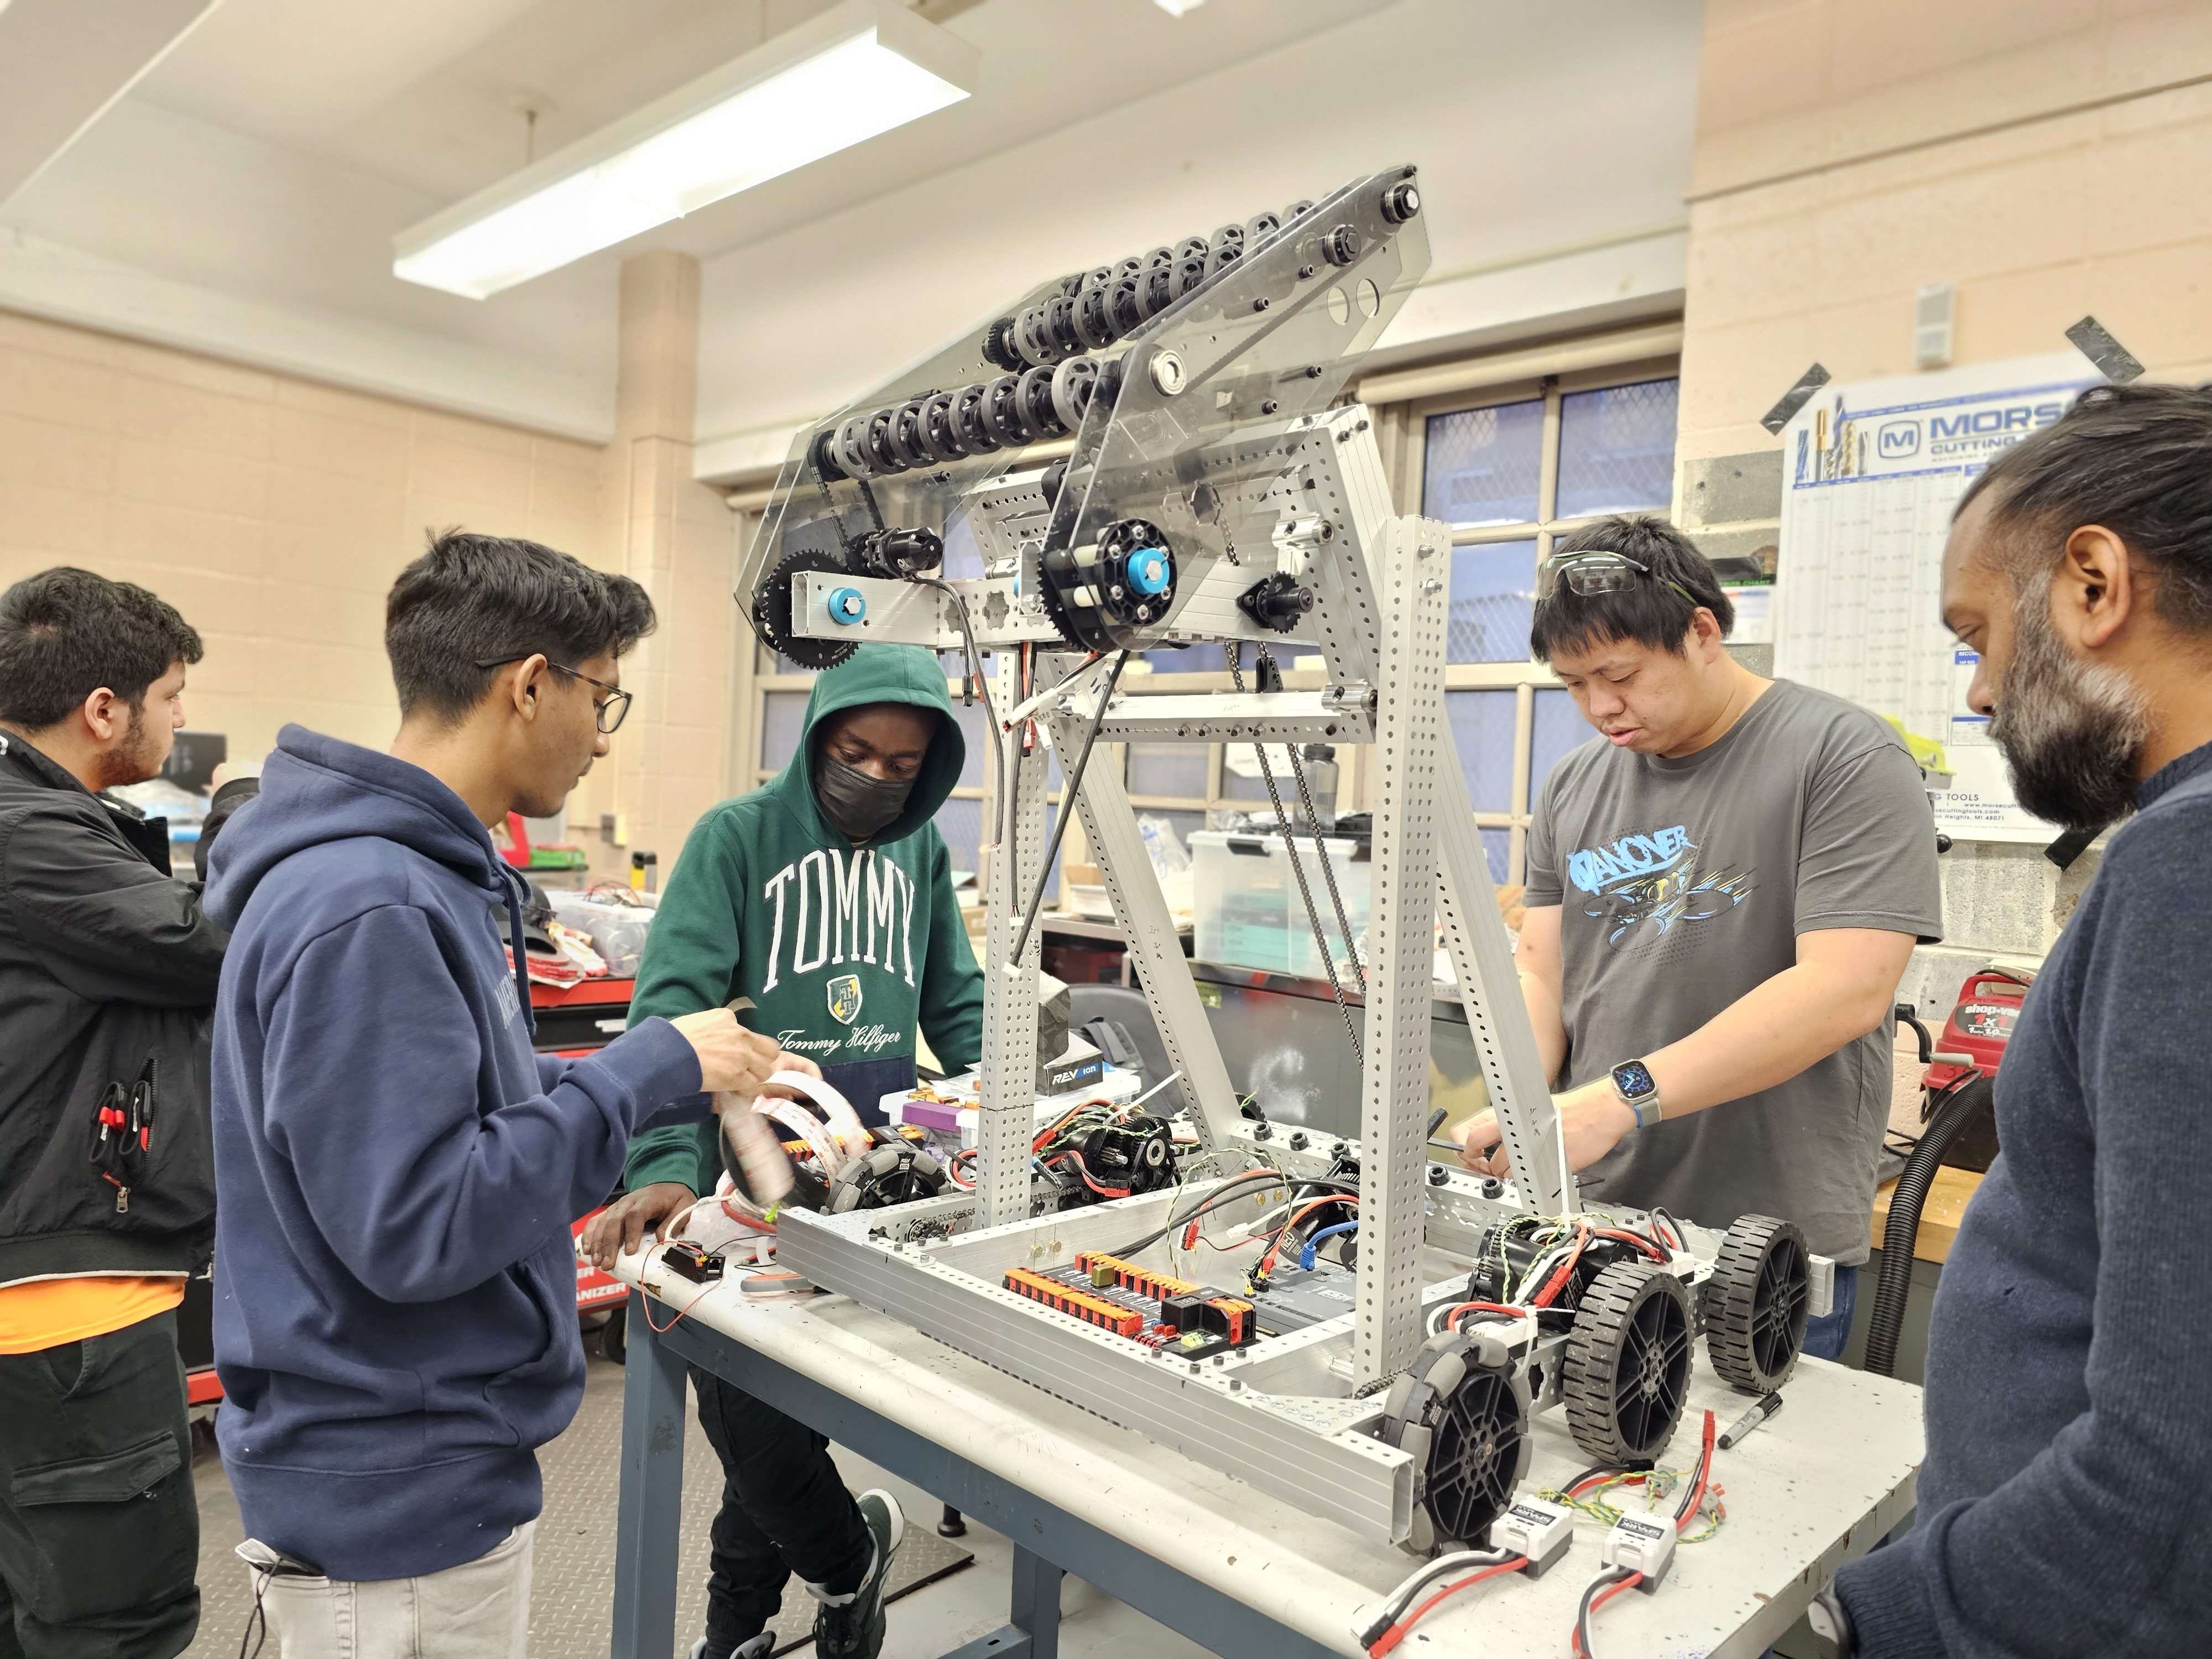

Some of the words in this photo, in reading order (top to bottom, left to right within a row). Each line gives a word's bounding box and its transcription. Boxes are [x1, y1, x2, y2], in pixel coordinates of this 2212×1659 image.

[1929, 403, 2073, 439] MORS
[763, 848, 915, 994] TOMMY
[776, 1029, 842, 1056] Tommy
[846, 1024, 901, 1052] Hilfiger
[1052, 1068, 1079, 1086] REV
[1083, 1065, 1097, 1075] ion
